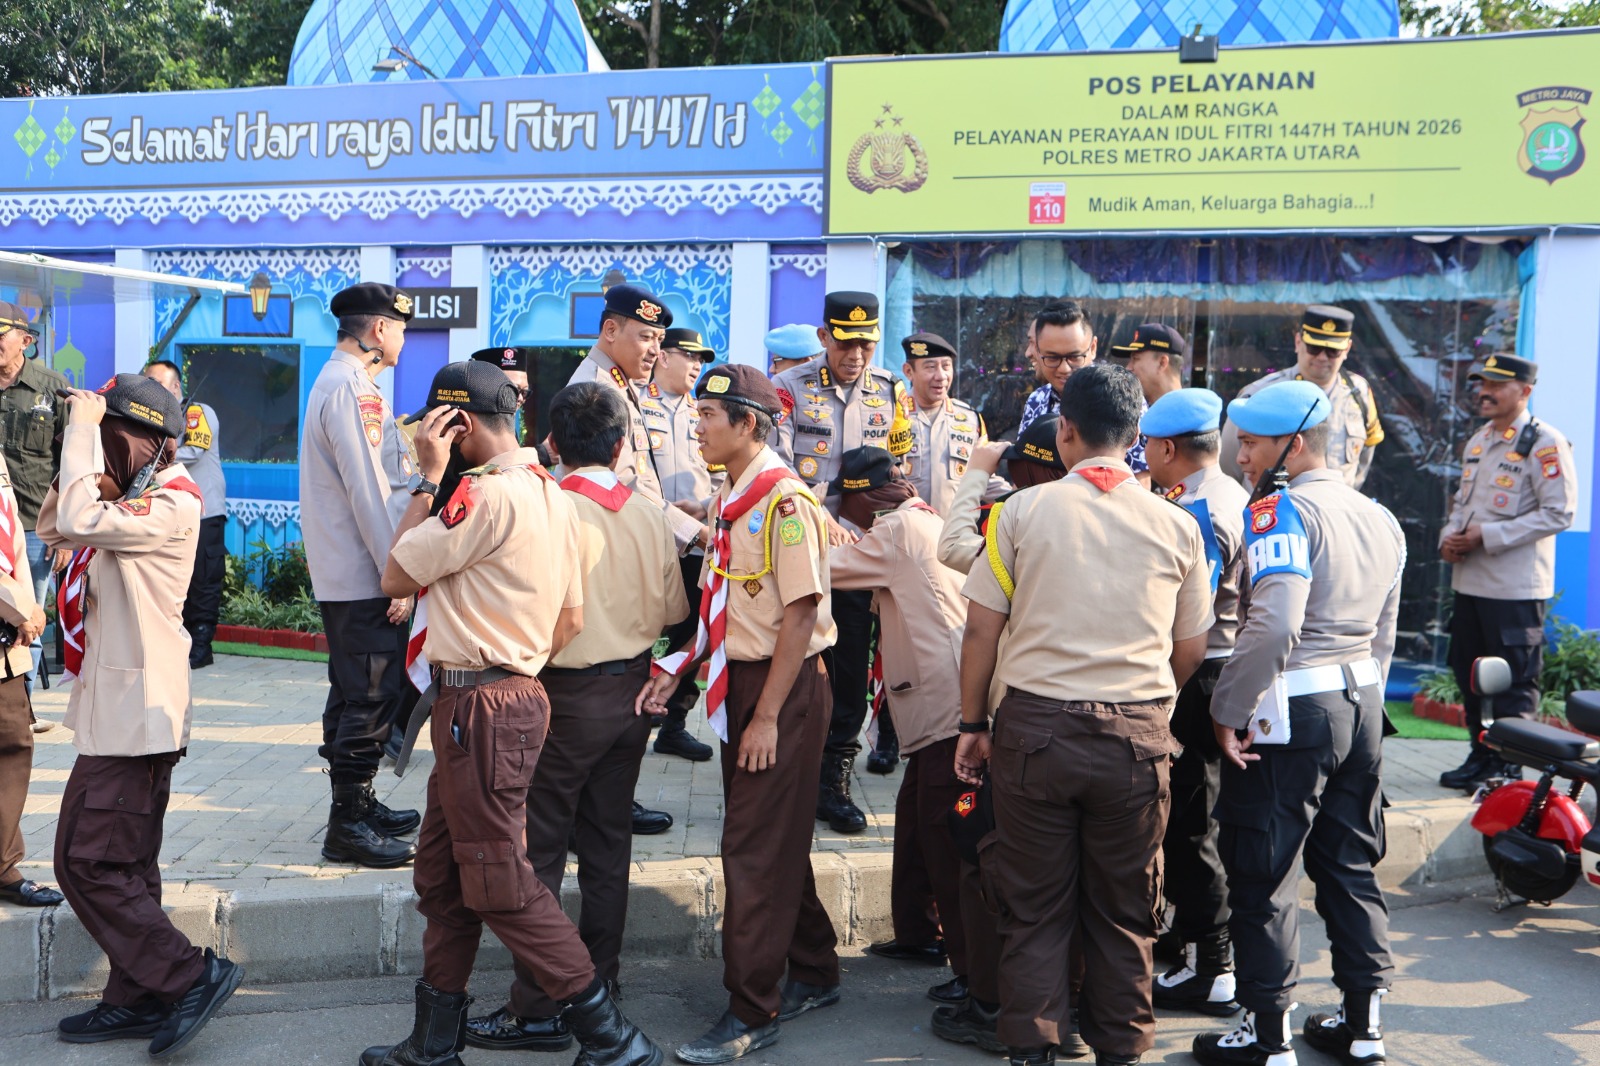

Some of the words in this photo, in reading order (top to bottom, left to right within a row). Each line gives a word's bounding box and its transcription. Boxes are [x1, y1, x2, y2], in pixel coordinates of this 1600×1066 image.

[1088, 76, 1141, 96] POS
[1151, 71, 1315, 94] PELAYANAN
[1521, 89, 1559, 104] METRO
[1560, 89, 1585, 101] JAYA
[1122, 104, 1189, 120] DALAM
[1195, 102, 1279, 118] RANGKA
[81, 115, 233, 165] Selamat
[236, 110, 320, 160] Hari
[325, 117, 413, 170] raya
[420, 101, 498, 155] Idul
[504, 99, 599, 152] Fitri
[953, 129, 1062, 146] PELAYANAN
[1069, 126, 1169, 143] PERAYAAN
[1175, 125, 1219, 141] IDUL
[1225, 123, 1273, 140] FITRI
[1279, 122, 1335, 139] 1447H
[1342, 120, 1410, 137] TAHUN
[1416, 119, 1462, 136] 2026
[1043, 149, 1118, 165] POLRES
[1124, 147, 1191, 164] METRO
[1197, 145, 1288, 163] JAKARTA
[1294, 144, 1360, 161] UTARA
[1034, 202, 1061, 218] 110
[1088, 197, 1137, 213] Mudik
[1143, 196, 1195, 213] Aman,
[1201, 195, 1277, 214] Keluarga
[1283, 193, 1375, 214] Bahagia...!
[414, 295, 460, 319] LISI
[950, 433, 973, 445] POLRI
